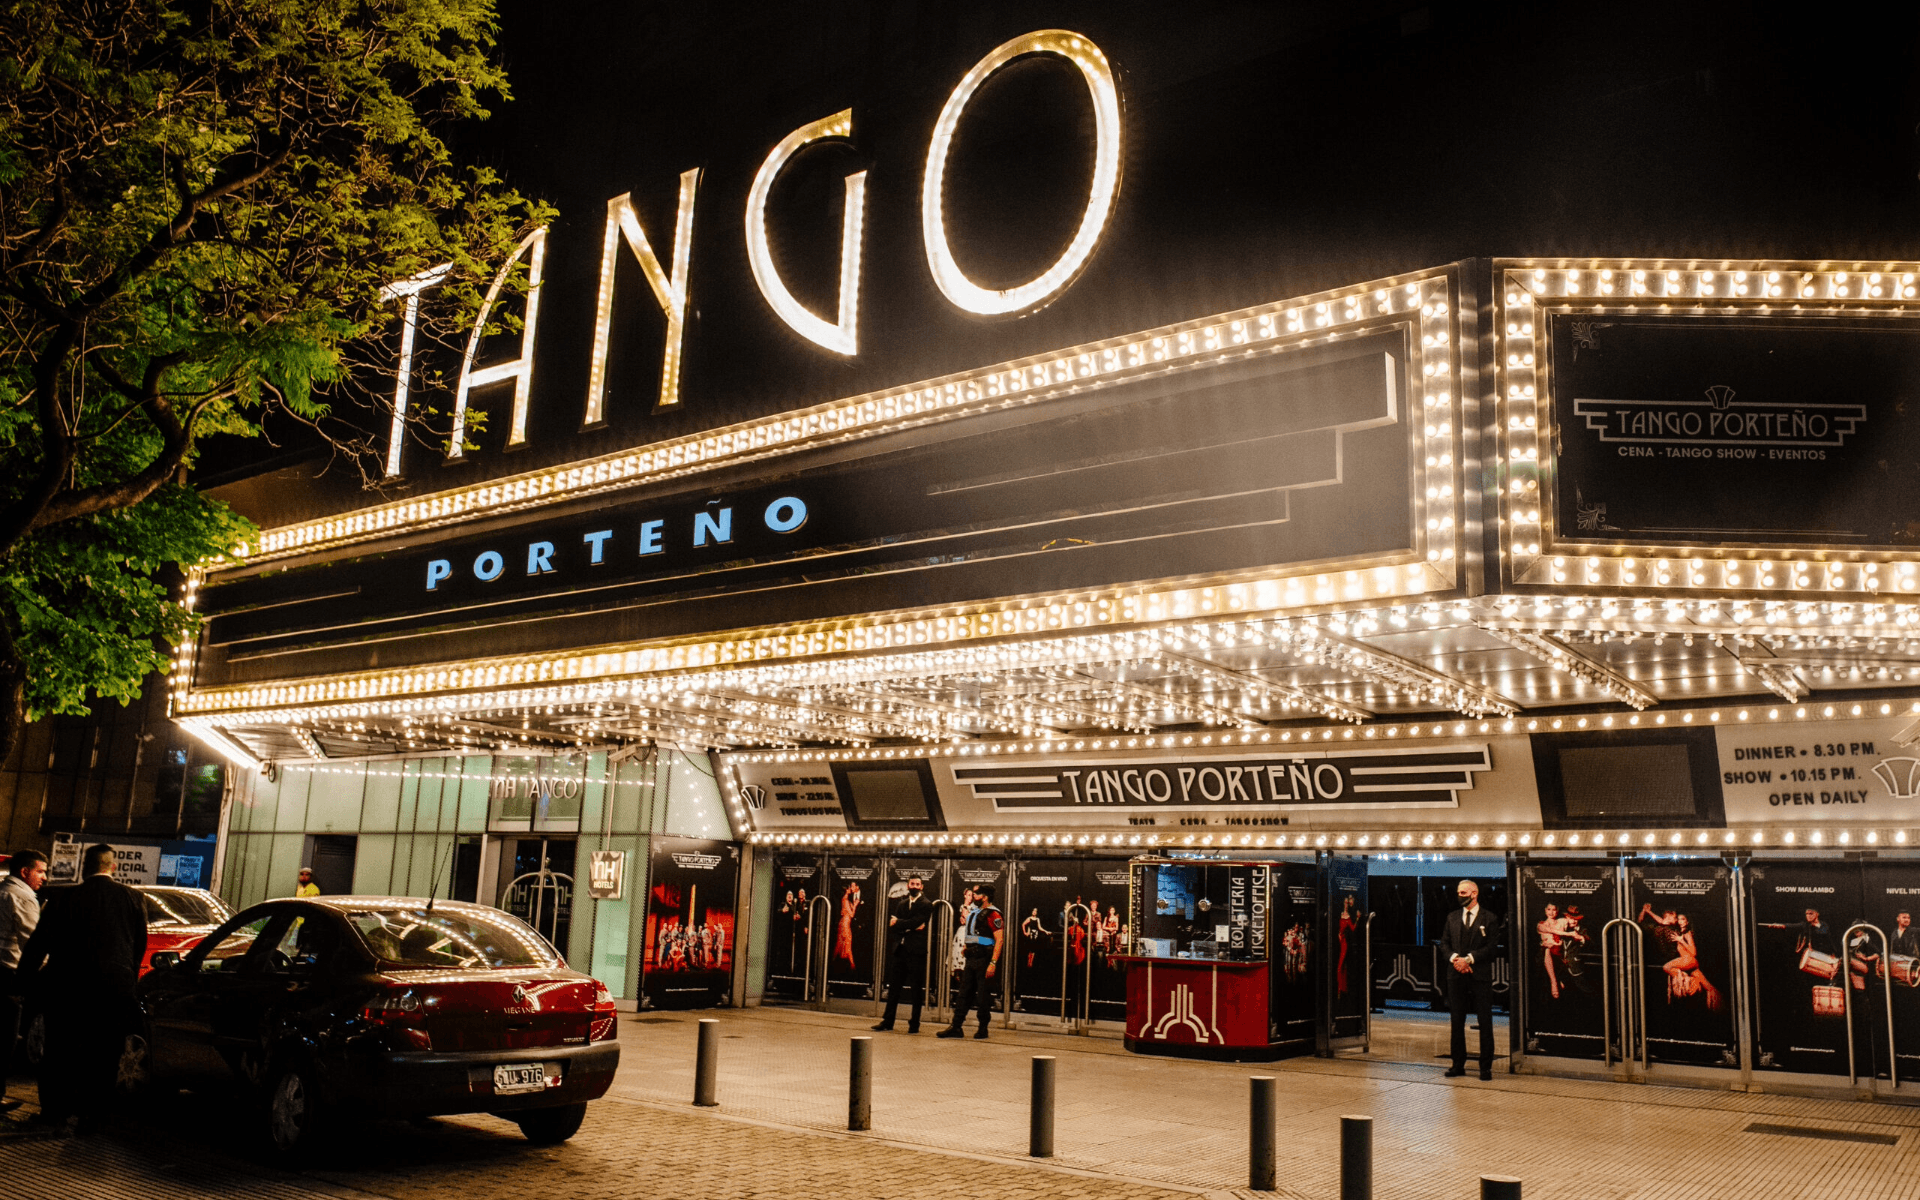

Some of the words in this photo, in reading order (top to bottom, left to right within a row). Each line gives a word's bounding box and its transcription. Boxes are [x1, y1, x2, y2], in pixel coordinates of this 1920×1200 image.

[379, 28, 1125, 478] TANGO
[1615, 410, 1702, 435] TANGO
[1709, 409, 1829, 438] PORTEÑO
[1617, 446, 1655, 458] CENA
[1665, 447, 1713, 459] TANGO
[1716, 448, 1757, 460] SHOW
[1768, 449, 1827, 461] EVENTOS
[425, 496, 809, 592] PORTEÑO
[1733, 745, 1797, 761] DINNER
[1813, 743, 1846, 757] 8.30
[1062, 769, 1172, 803] TANGO
[1177, 758, 1344, 803] PORTEÑO
[1723, 770, 1772, 785] SHOW
[1790, 768, 1827, 782] 10.15
[522, 778, 578, 799] TANGO
[1768, 791, 1815, 807] OPEN
[1820, 789, 1869, 805] DAILY
[113, 850, 142, 860] DER
[118, 862, 148, 873] ICIAL
[593, 881, 614, 889] HOTELS
[1543, 881, 1565, 889] TANGO
[1653, 881, 1675, 889] TANGO
[1797, 886, 1835, 894] MALAMBO
[1886, 887, 1908, 895] NIVEL
[1231, 877, 1245, 949] BOLETERIA
[521, 1069, 543, 1085] 976
